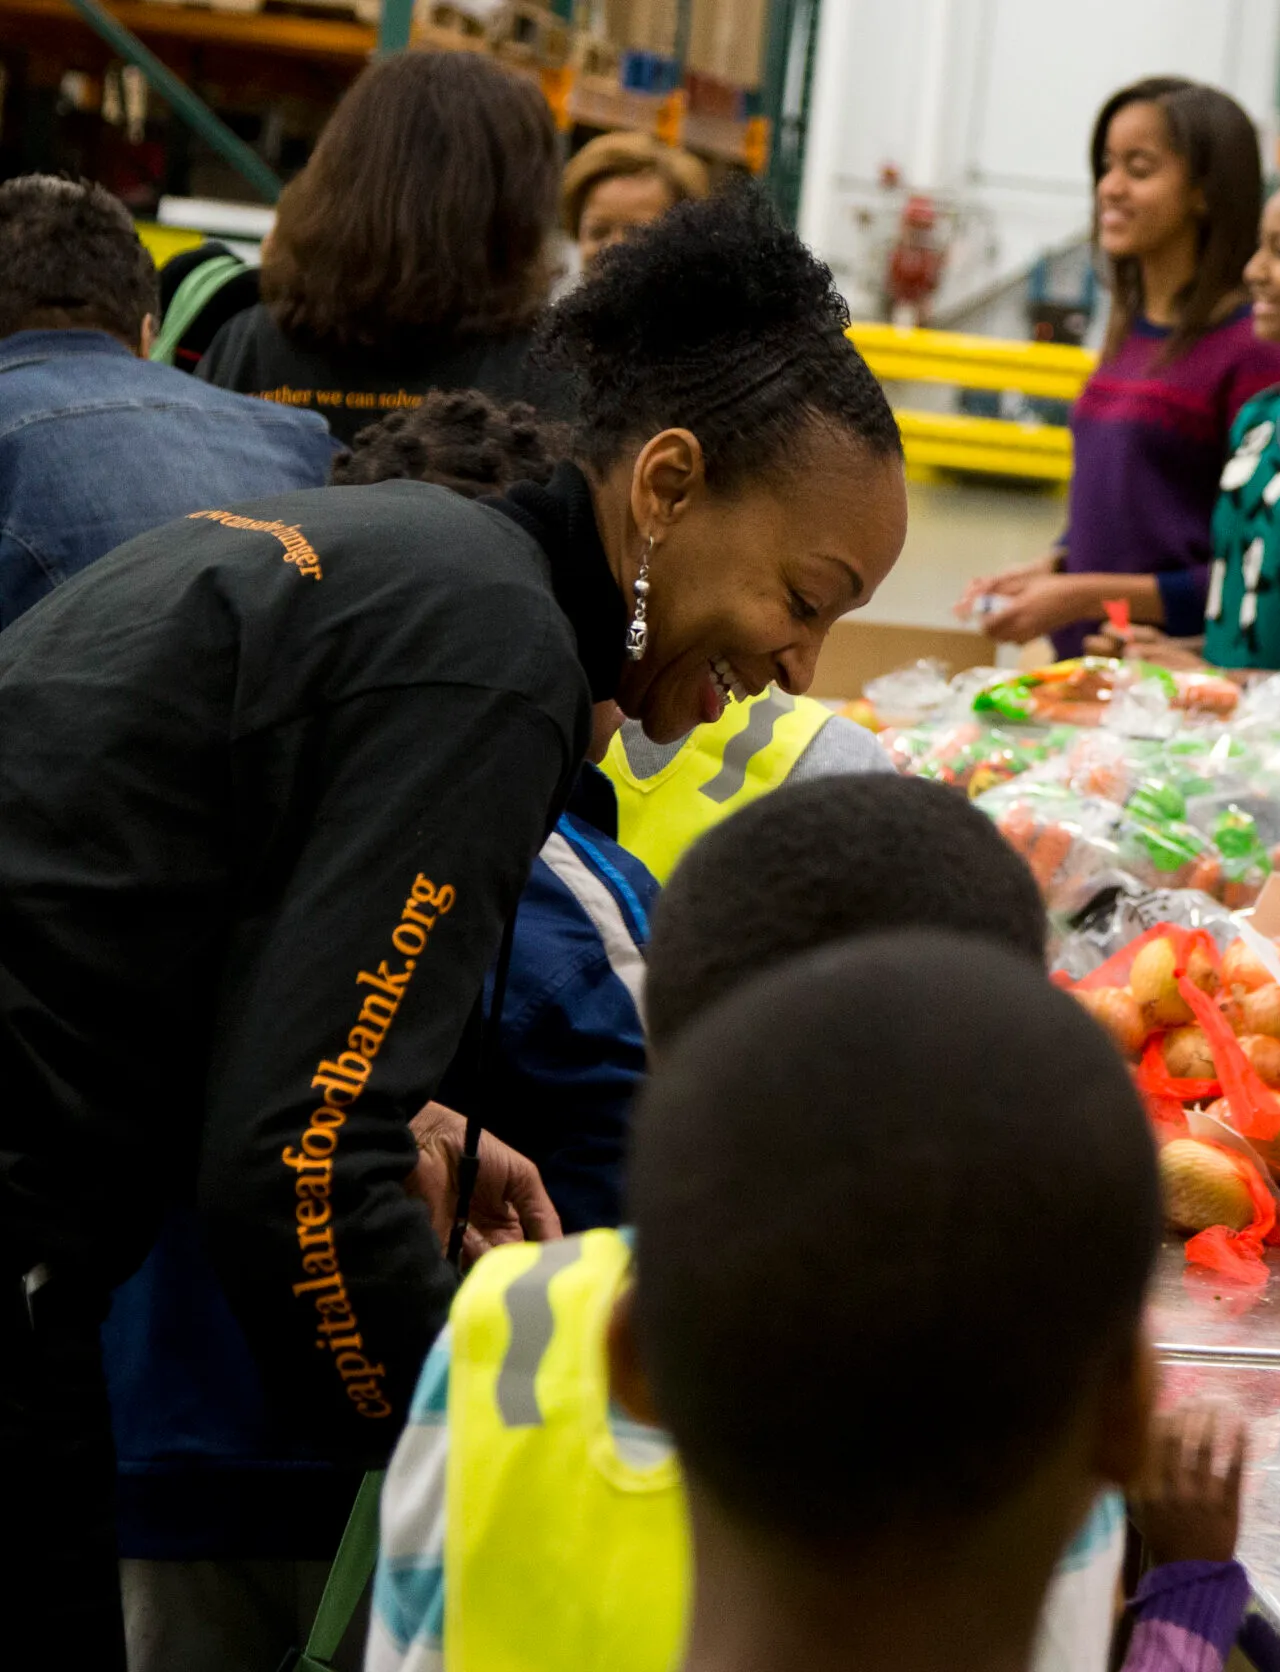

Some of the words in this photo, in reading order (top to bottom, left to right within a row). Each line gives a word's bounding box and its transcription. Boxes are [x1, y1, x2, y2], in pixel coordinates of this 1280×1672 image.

[316, 390, 343, 406] we
[345, 391, 374, 408] can
[282, 872, 457, 1419] capitalareafoodbank.org
